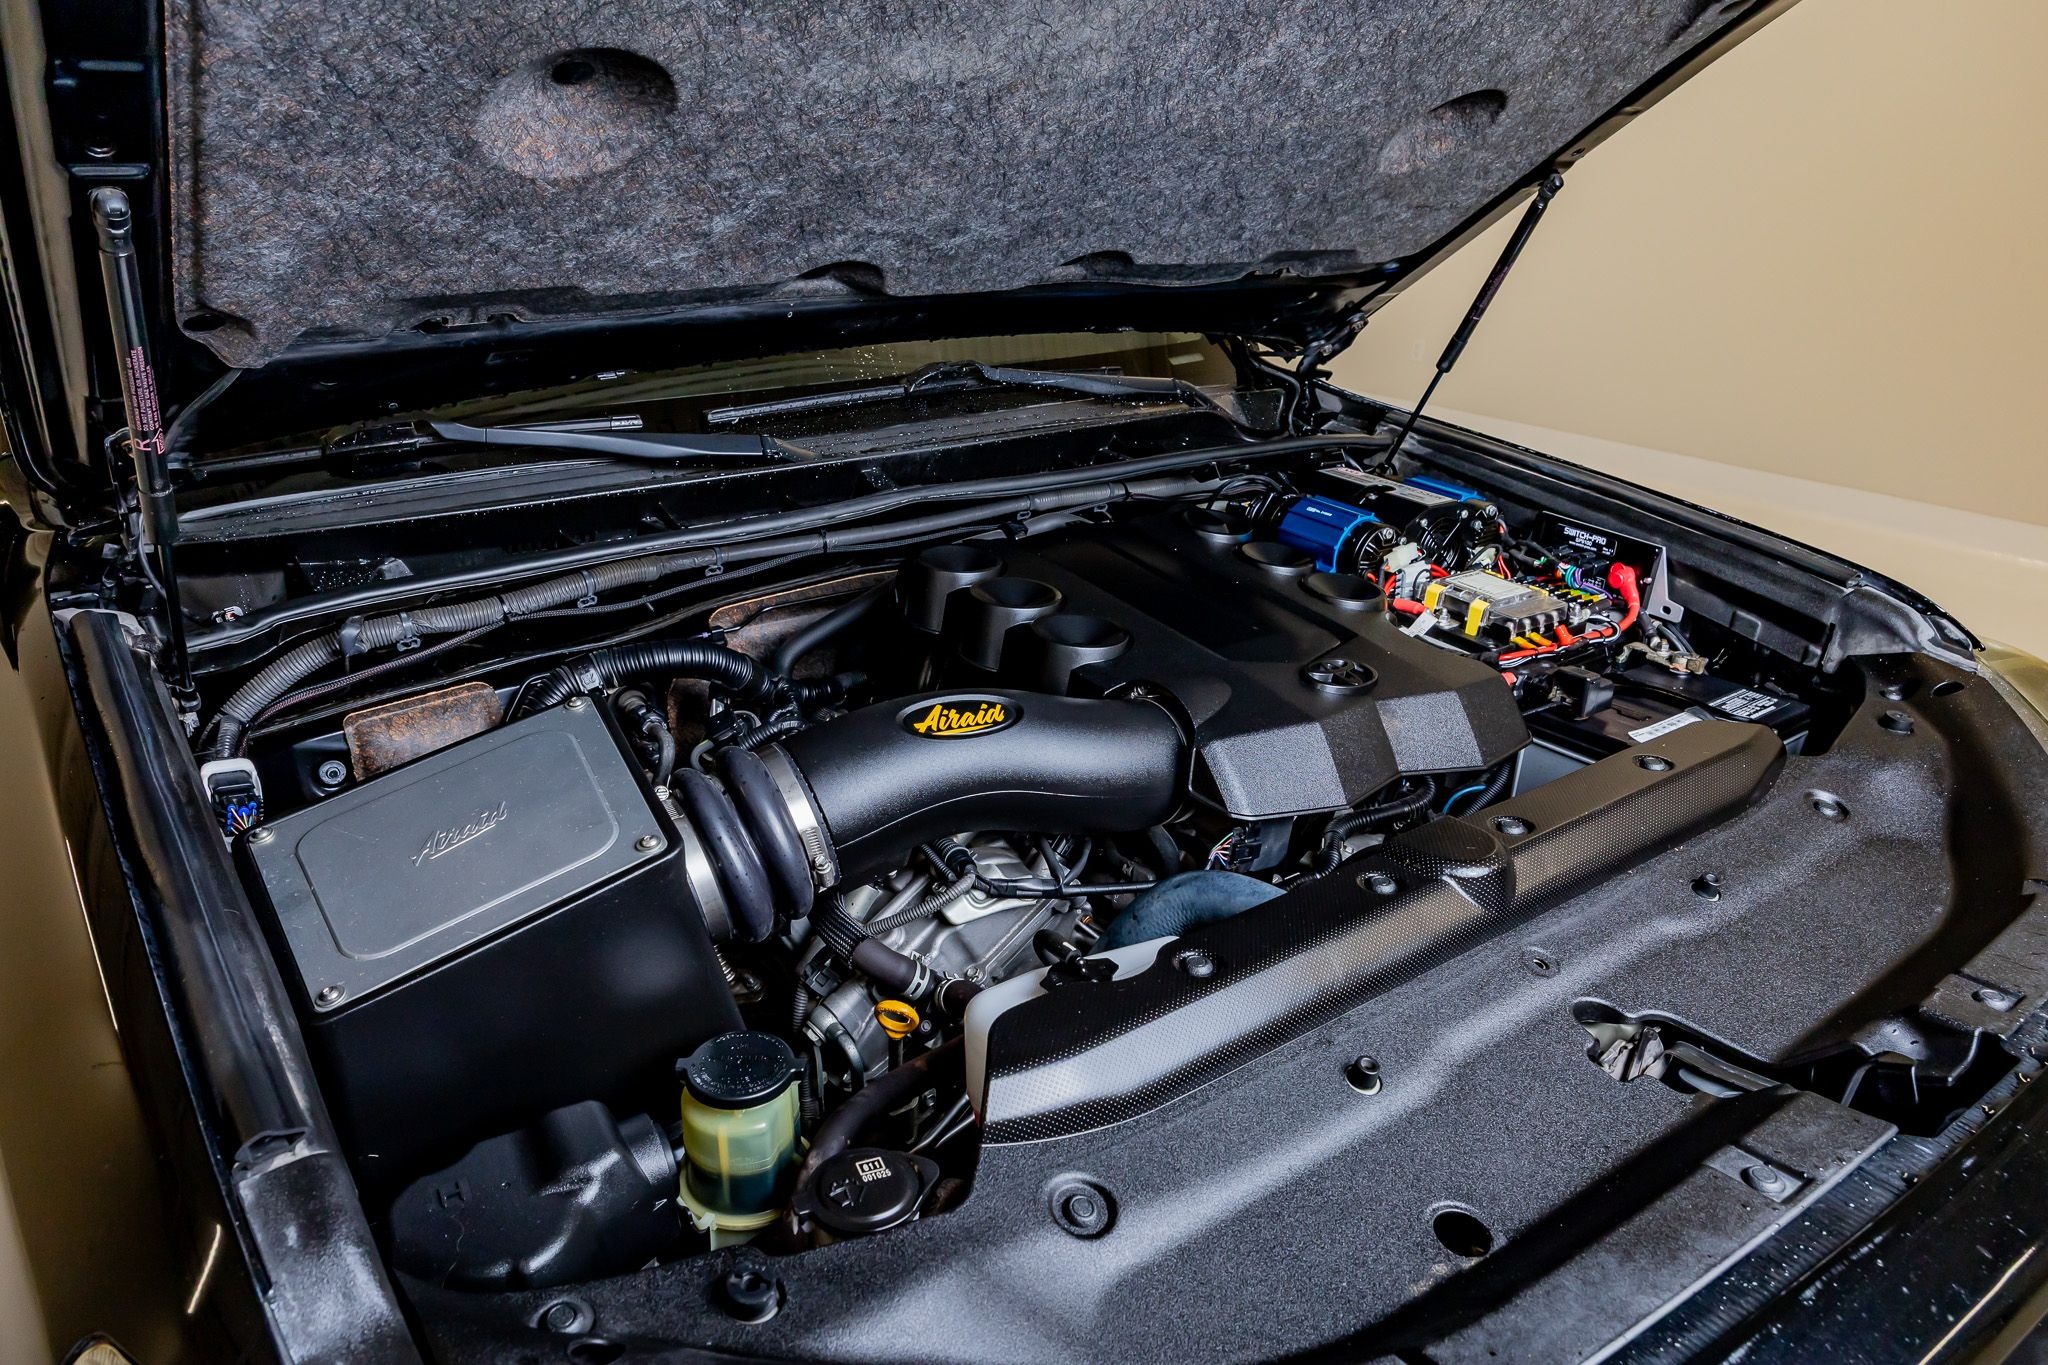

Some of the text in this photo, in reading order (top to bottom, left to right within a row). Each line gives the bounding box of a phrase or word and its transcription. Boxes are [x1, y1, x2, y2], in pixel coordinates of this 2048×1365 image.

[131, 350, 140, 378] INCINERATE
[137, 346, 145, 370] PRESSION
[137, 388, 146, 412] PUNCTURE
[133, 438, 151, 450] R
[913, 703, 1005, 734] Airaid
[410, 800, 508, 867] Airaid
